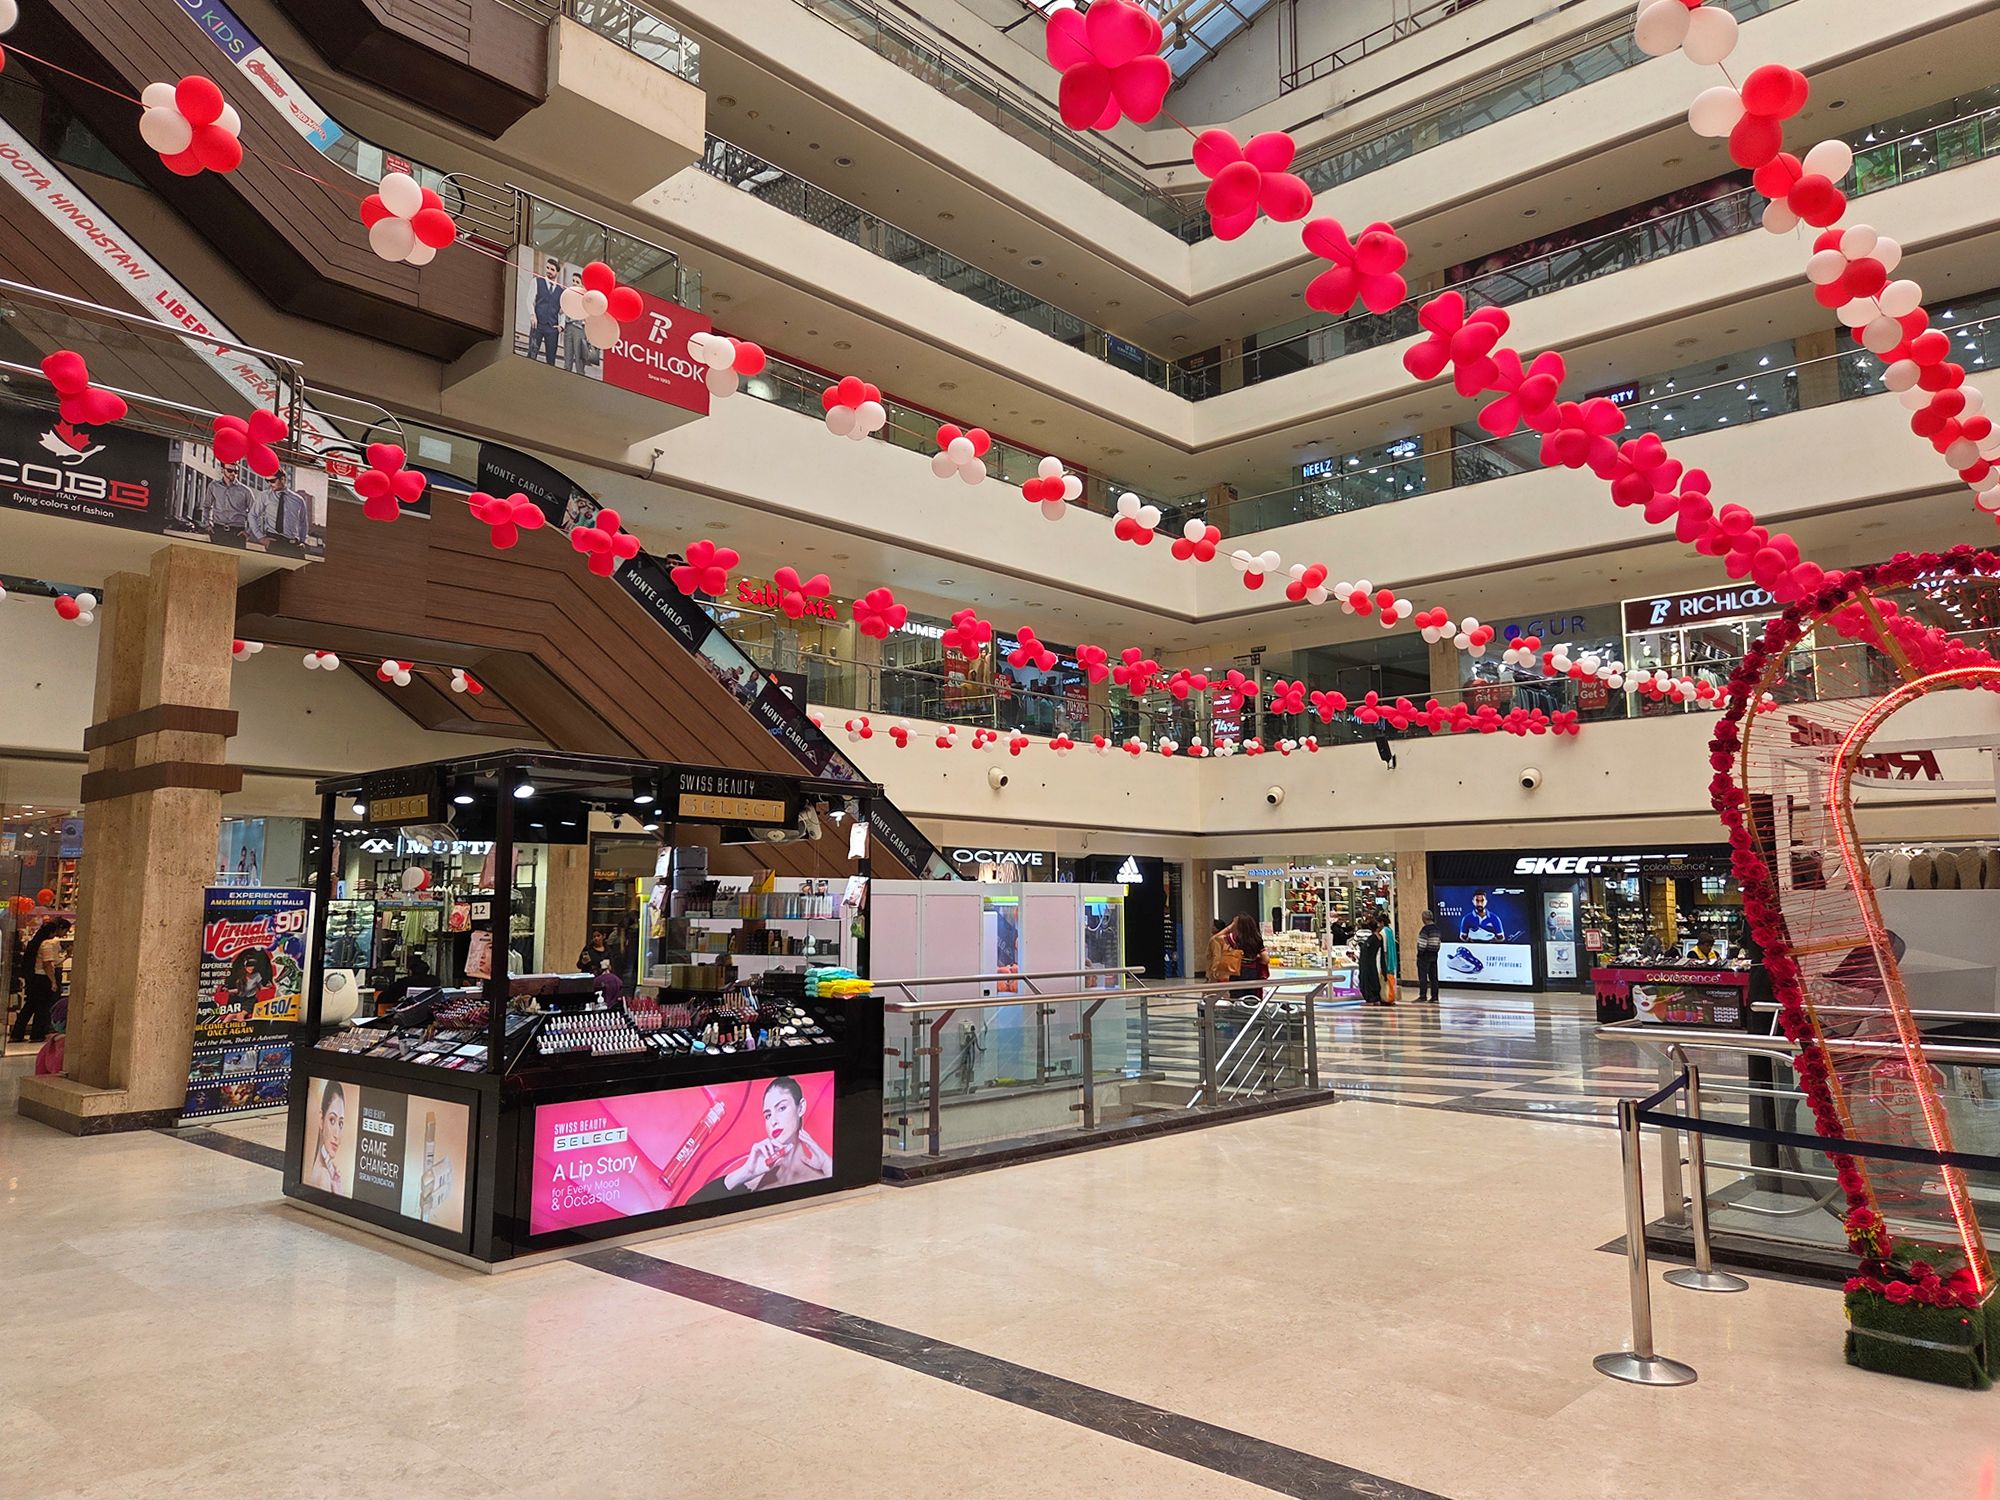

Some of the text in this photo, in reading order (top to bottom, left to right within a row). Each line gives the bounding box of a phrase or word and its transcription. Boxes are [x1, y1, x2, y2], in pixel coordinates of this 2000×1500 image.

[200, 10, 245, 54] KIDS
[48, 193, 150, 280] HINDUSTANI
[233, 364, 279, 401] MERA
[611, 338, 705, 384] RICHLOOK
[1303, 458, 1332, 478] HEELZ
[485, 462, 545, 497] MONTE CARLO
[13, 492, 114, 518] flying colors of fashion
[56, 491, 78, 501] ITALY
[626, 569, 683, 626] MONTE CARLO
[737, 580, 838, 619] Sabata
[1581, 688, 1606, 698] Get 3
[761, 702, 786, 730] MONTE
[785, 726, 808, 753] CARLO
[680, 774, 755, 795] SWISS BEAUTY
[683, 798, 782, 819] SELECT
[871, 811, 909, 857] MONTE CARLO
[952, 849, 1043, 866] OCTAVE
[473, 905, 486, 915] 12
[276, 910, 306, 934] 9D
[205, 918, 269, 953] Virtual
[214, 934, 275, 960] Cinema
[220, 1003, 242, 1015] BAR
[195, 1023, 224, 1031] BECOME
[207, 1029, 227, 1037] ONCE
[364, 1120, 394, 1135] SELECT
[554, 1117, 607, 1136] SWISS BEAUTY
[361, 1137, 388, 1158] GAME
[556, 1129, 626, 1150] SELECT
[359, 1155, 399, 1179] CHANGER
[553, 1154, 638, 1182] A Lip Story
[552, 1177, 620, 1198] for Every Mood
[551, 1188, 620, 1211] & Occasion
